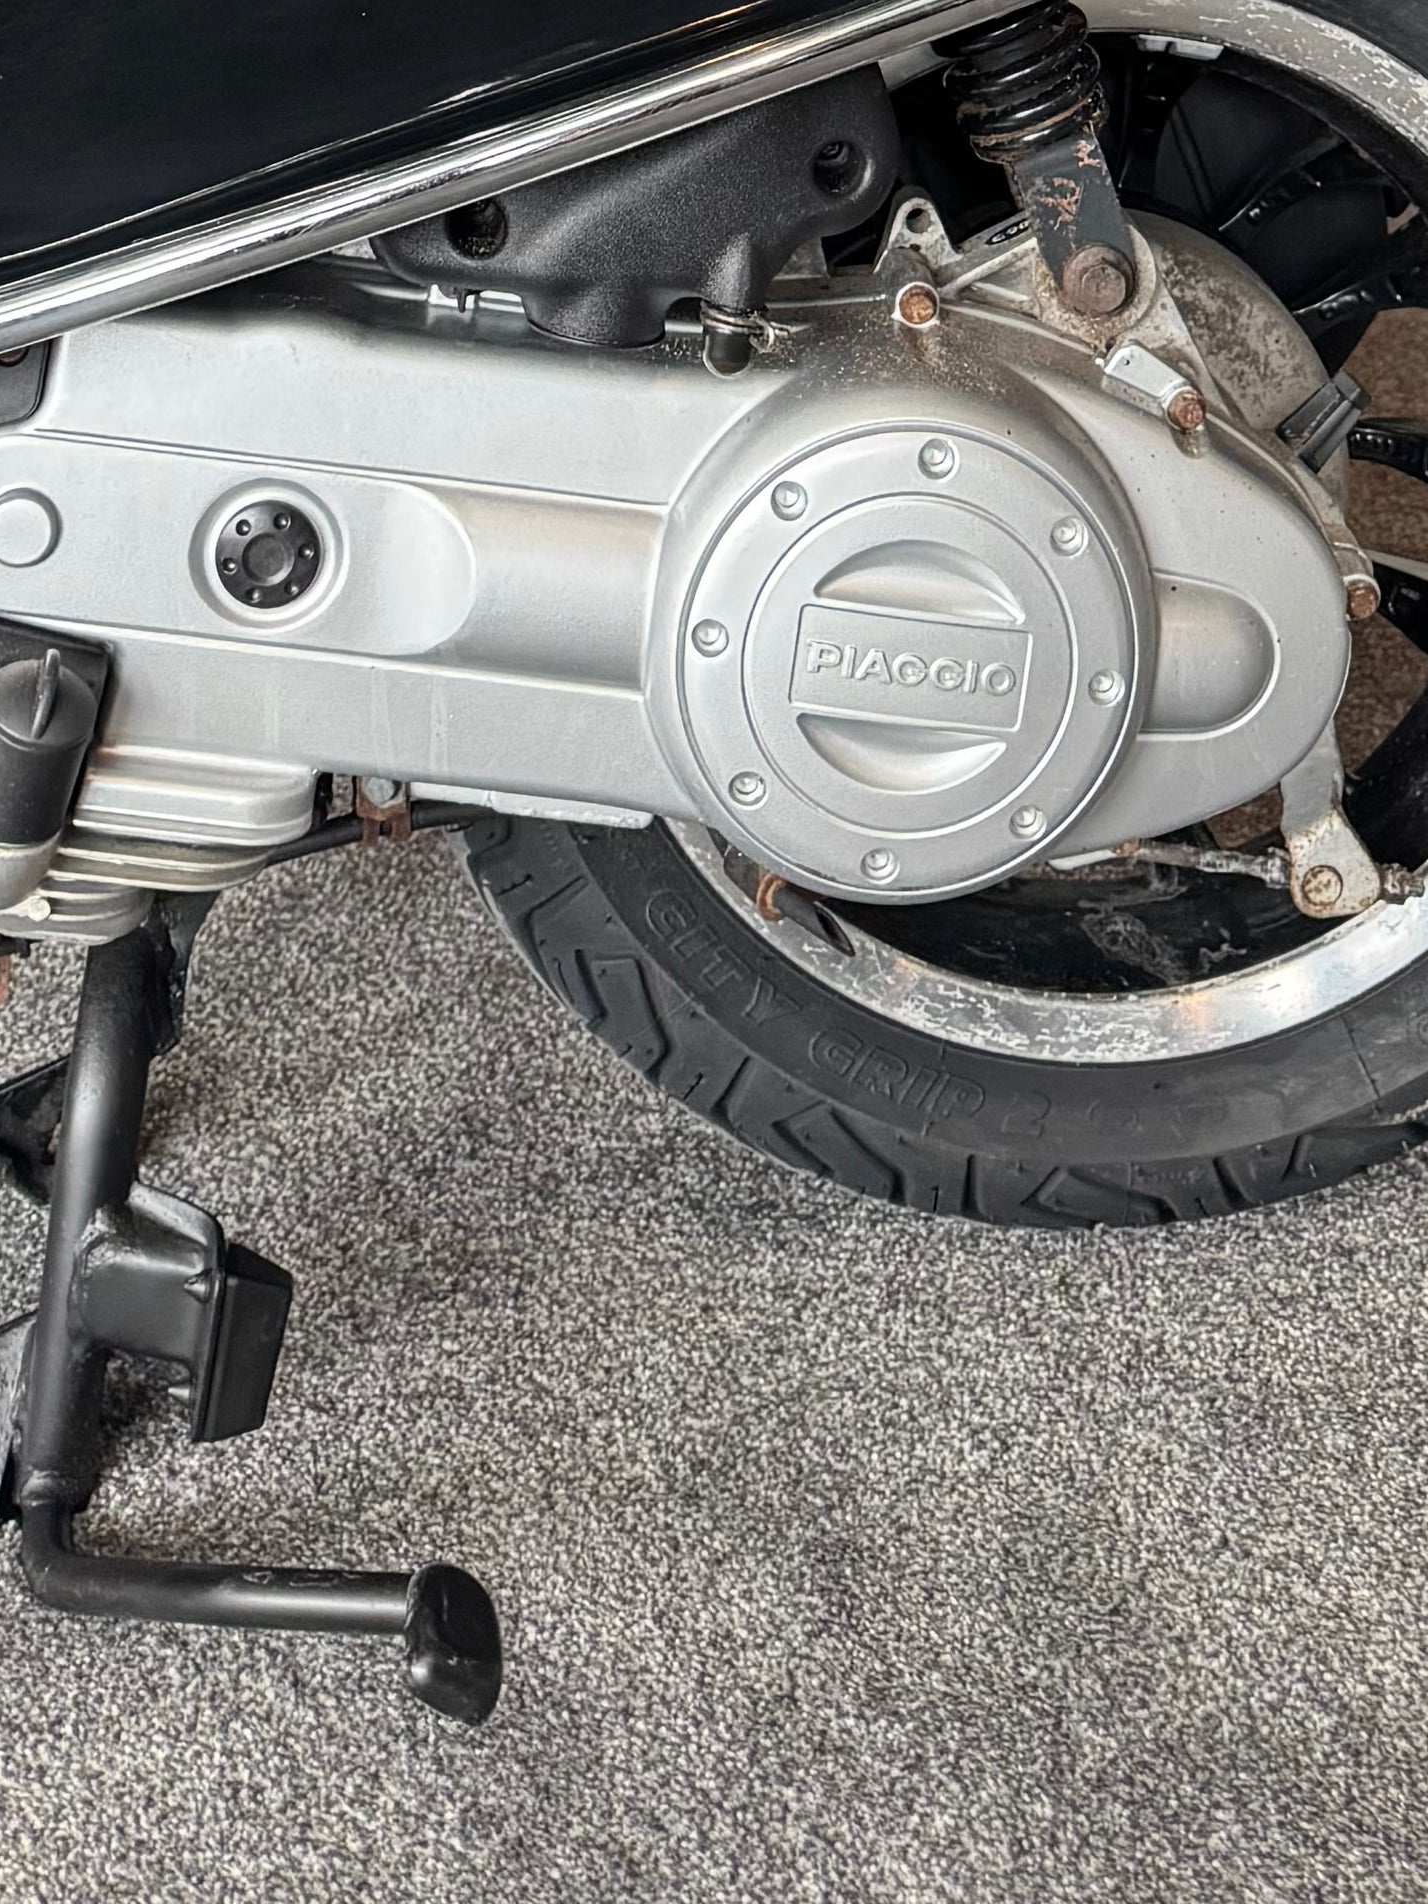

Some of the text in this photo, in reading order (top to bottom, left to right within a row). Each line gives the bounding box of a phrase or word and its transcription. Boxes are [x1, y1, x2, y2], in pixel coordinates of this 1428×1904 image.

[805, 638, 1018, 697] PIAGGIO
[645, 888, 1053, 1138] CITY GRIP 2
